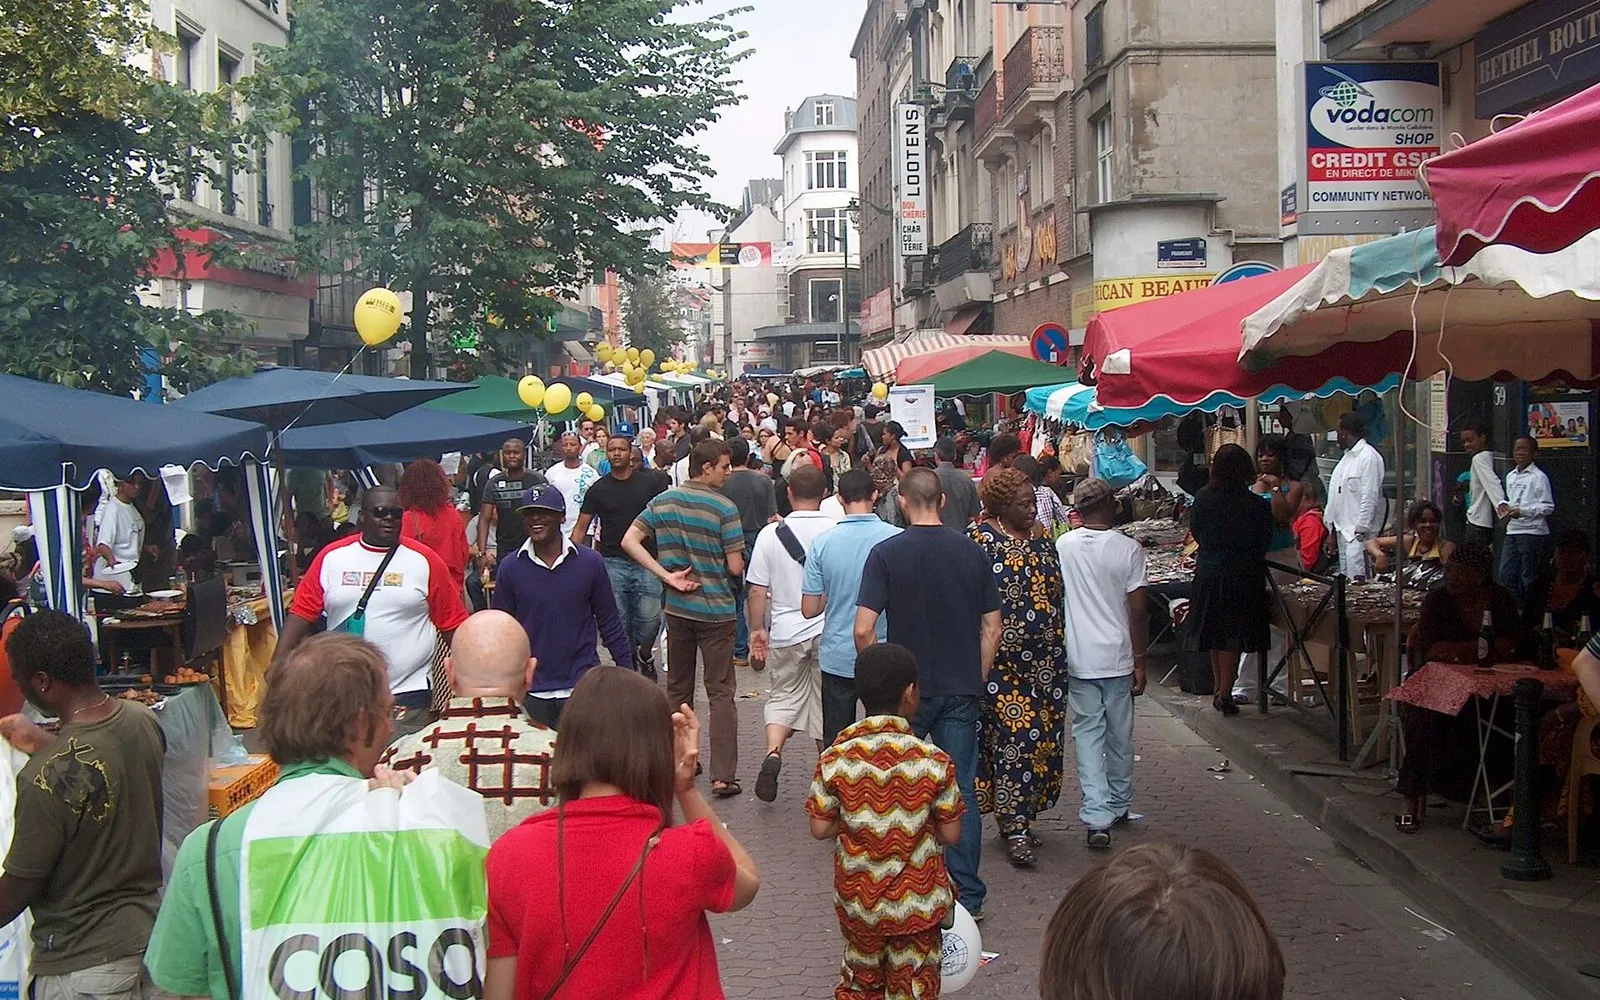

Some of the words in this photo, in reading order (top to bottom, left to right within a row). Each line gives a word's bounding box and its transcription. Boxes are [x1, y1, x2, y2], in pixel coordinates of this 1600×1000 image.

[1479, 37, 1543, 84] BETHEL
[1326, 100, 1434, 123] vodacom
[1395, 133, 1434, 145] SHOP
[905, 109, 920, 197] LOOTENS
[1311, 152, 1387, 168] CREDIT
[1326, 169, 1339, 178] EN
[1341, 168, 1378, 178] DIRECT
[1380, 168, 1393, 178] DE
[1312, 191, 1379, 202] COMMUNITY
[903, 225, 921, 234] CHAR
[902, 234, 912, 242] CU
[903, 242, 923, 251] TERIE
